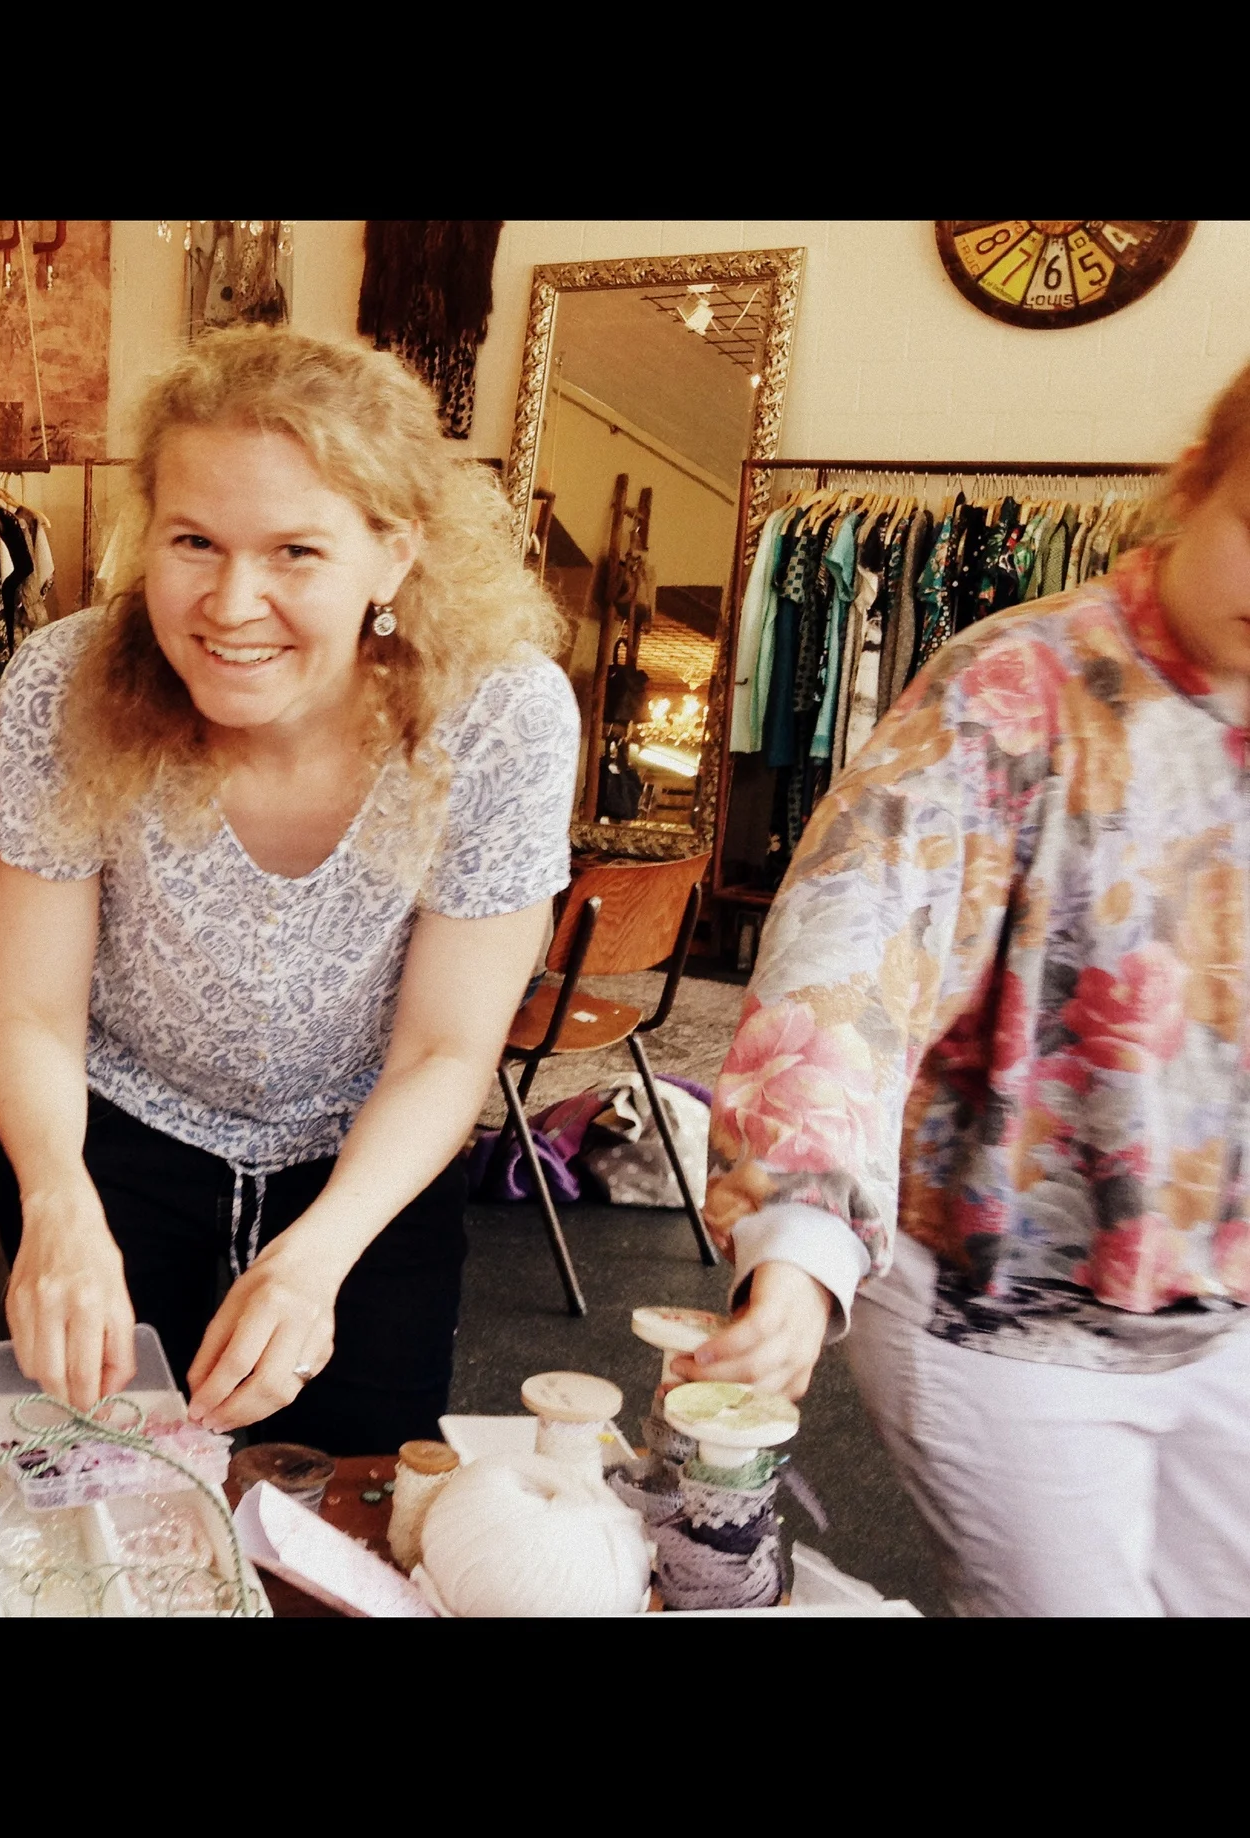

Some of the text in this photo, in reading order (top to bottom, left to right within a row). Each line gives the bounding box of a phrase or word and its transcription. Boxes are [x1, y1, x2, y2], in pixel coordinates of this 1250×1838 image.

[976, 229, 1011, 255] 8
[1102, 223, 1140, 253] 4
[1001, 246, 1034, 287] 7
[1044, 254, 1062, 290] 6
[1078, 251, 1106, 286] 5
